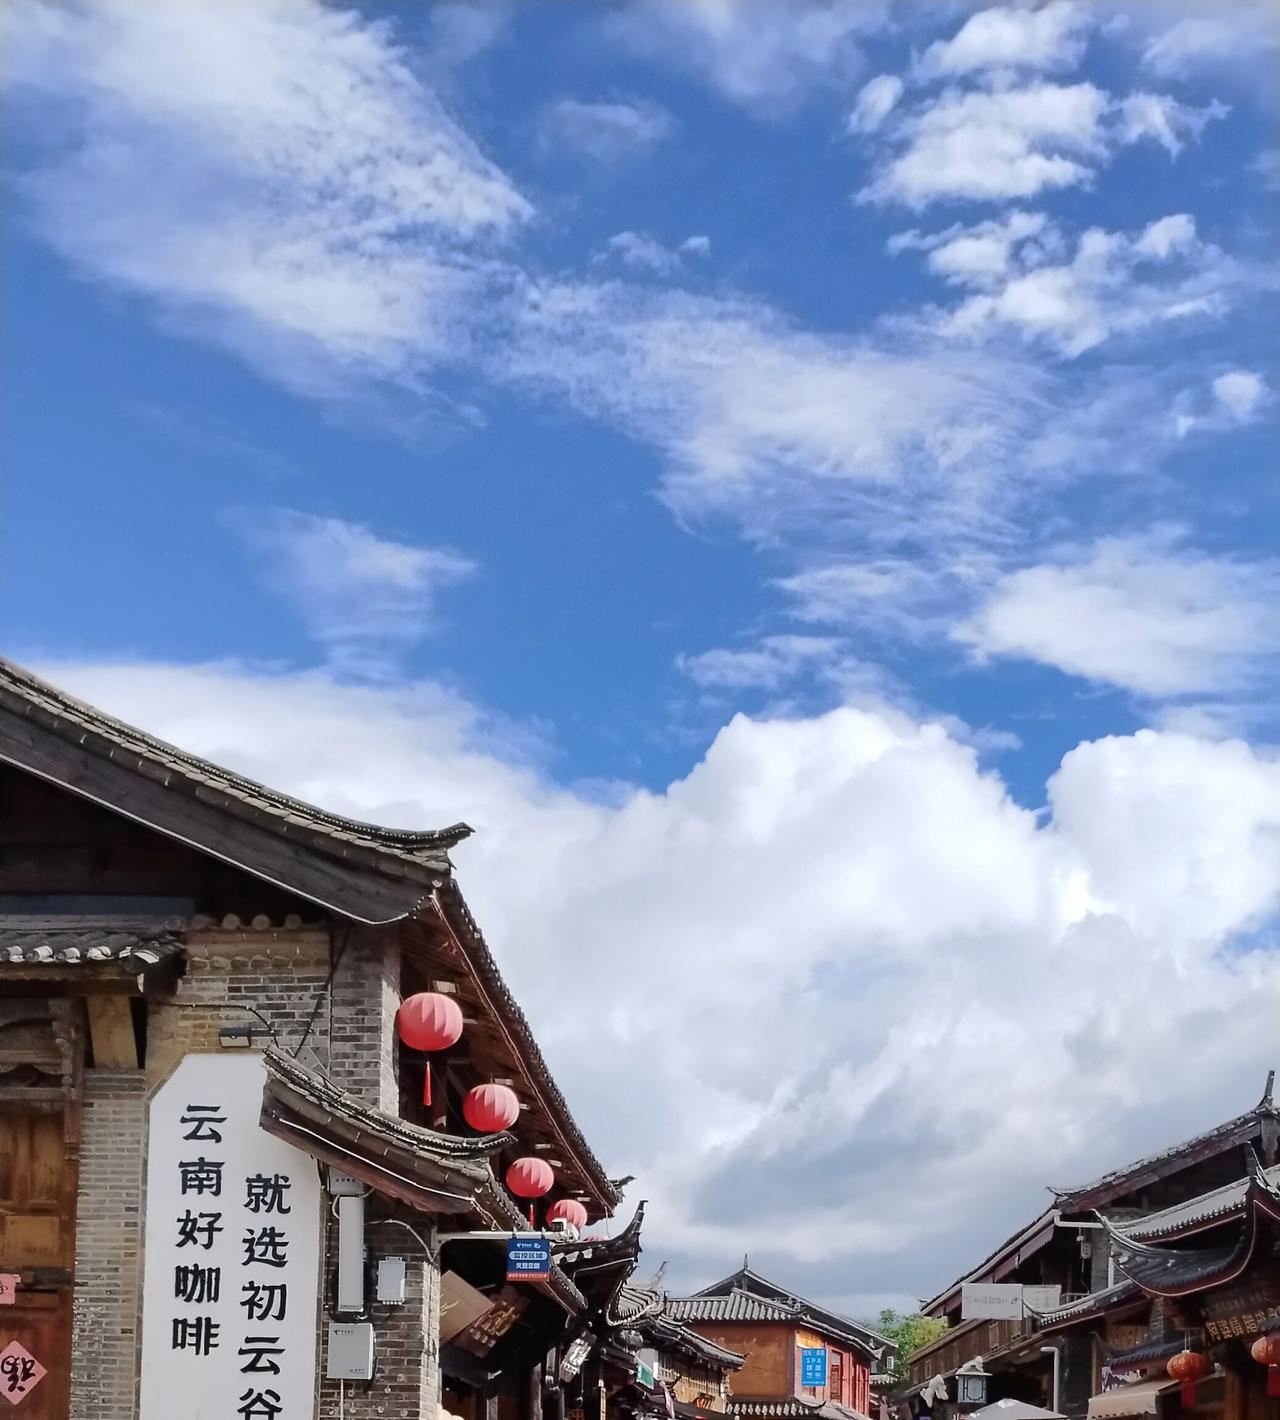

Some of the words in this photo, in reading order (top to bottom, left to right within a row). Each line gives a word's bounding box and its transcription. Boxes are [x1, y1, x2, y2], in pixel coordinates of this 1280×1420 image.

[172, 1103, 228, 1356] 云南好咖啡
